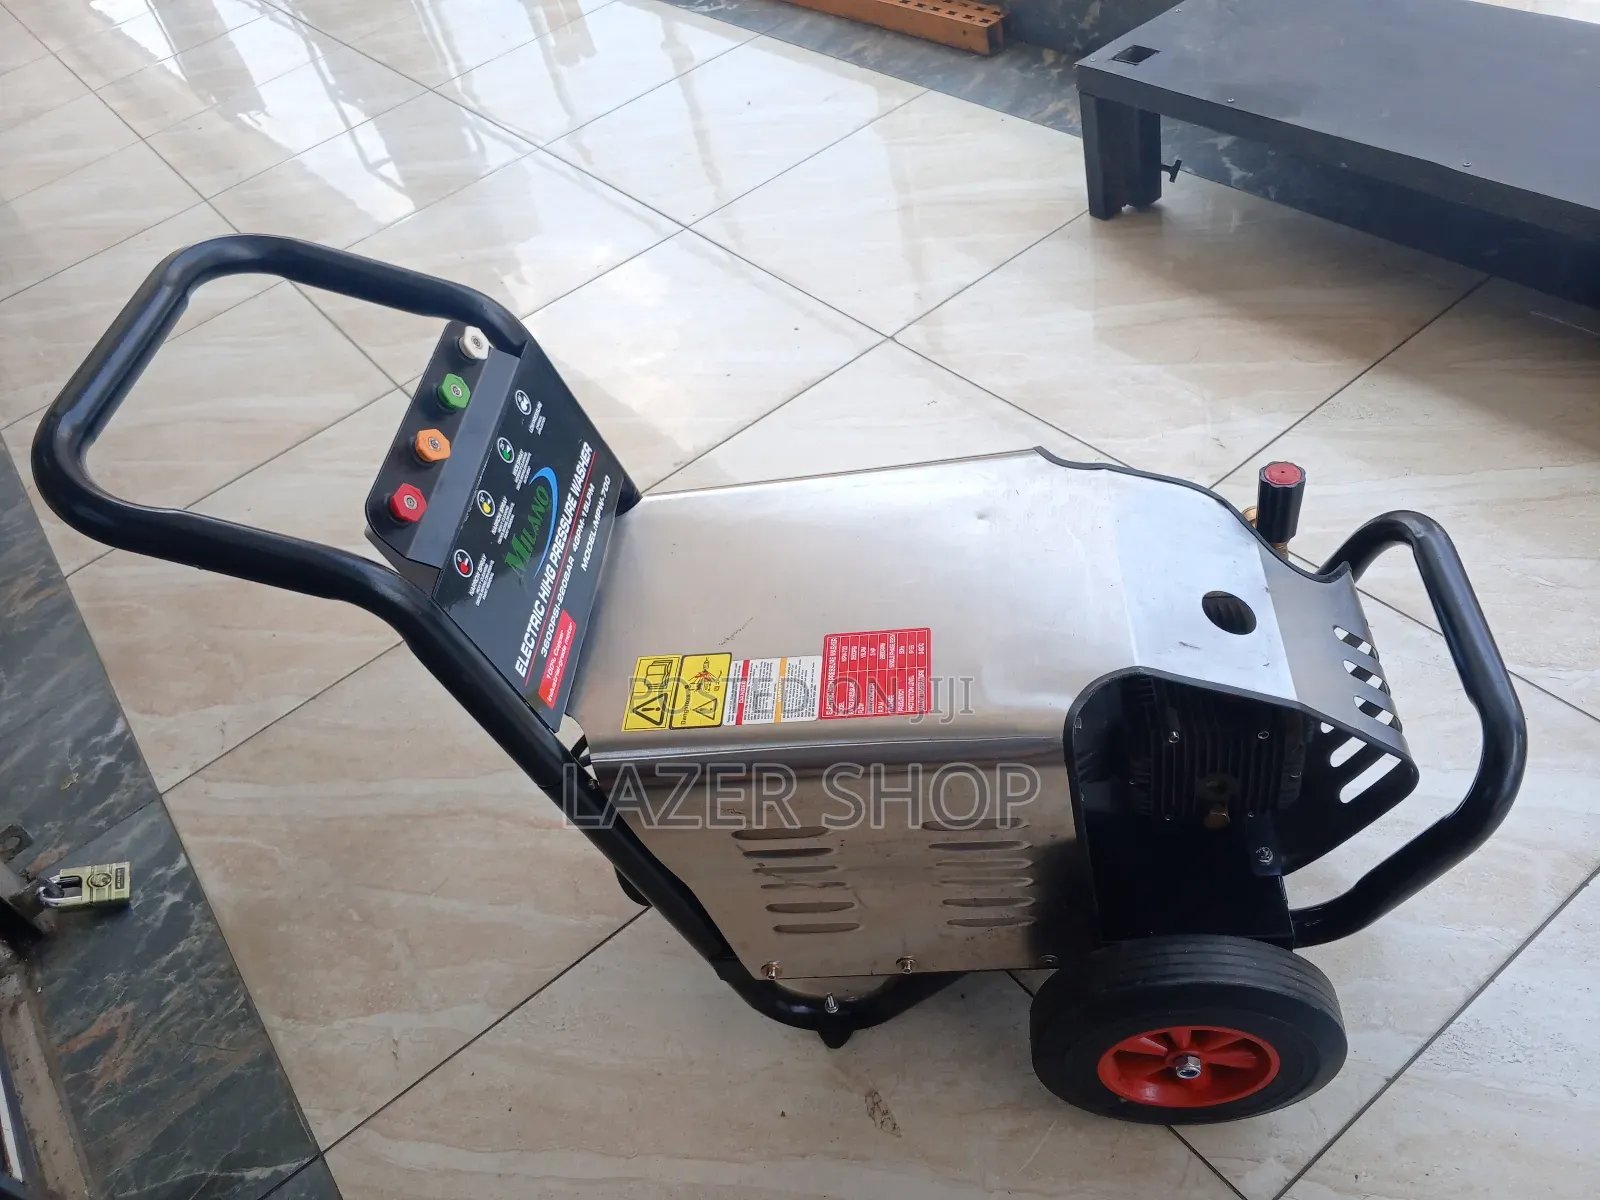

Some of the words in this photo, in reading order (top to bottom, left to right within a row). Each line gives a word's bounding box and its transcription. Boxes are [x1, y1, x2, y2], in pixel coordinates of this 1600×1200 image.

[504, 486, 550, 573] MILANO
[468, 572, 480, 596] NARROW
[478, 553, 488, 573] SPRAY
[515, 600, 546, 678] ELECTRIC
[538, 564, 557, 604] HIHG
[550, 492, 578, 568] PRESSURE
[570, 442, 592, 498] WASHER
[546, 656, 556, 680] 100%
[554, 630, 564, 656] Copper
[564, 622, 572, 646] motor
[828, 656, 836, 680] PRESSURE
